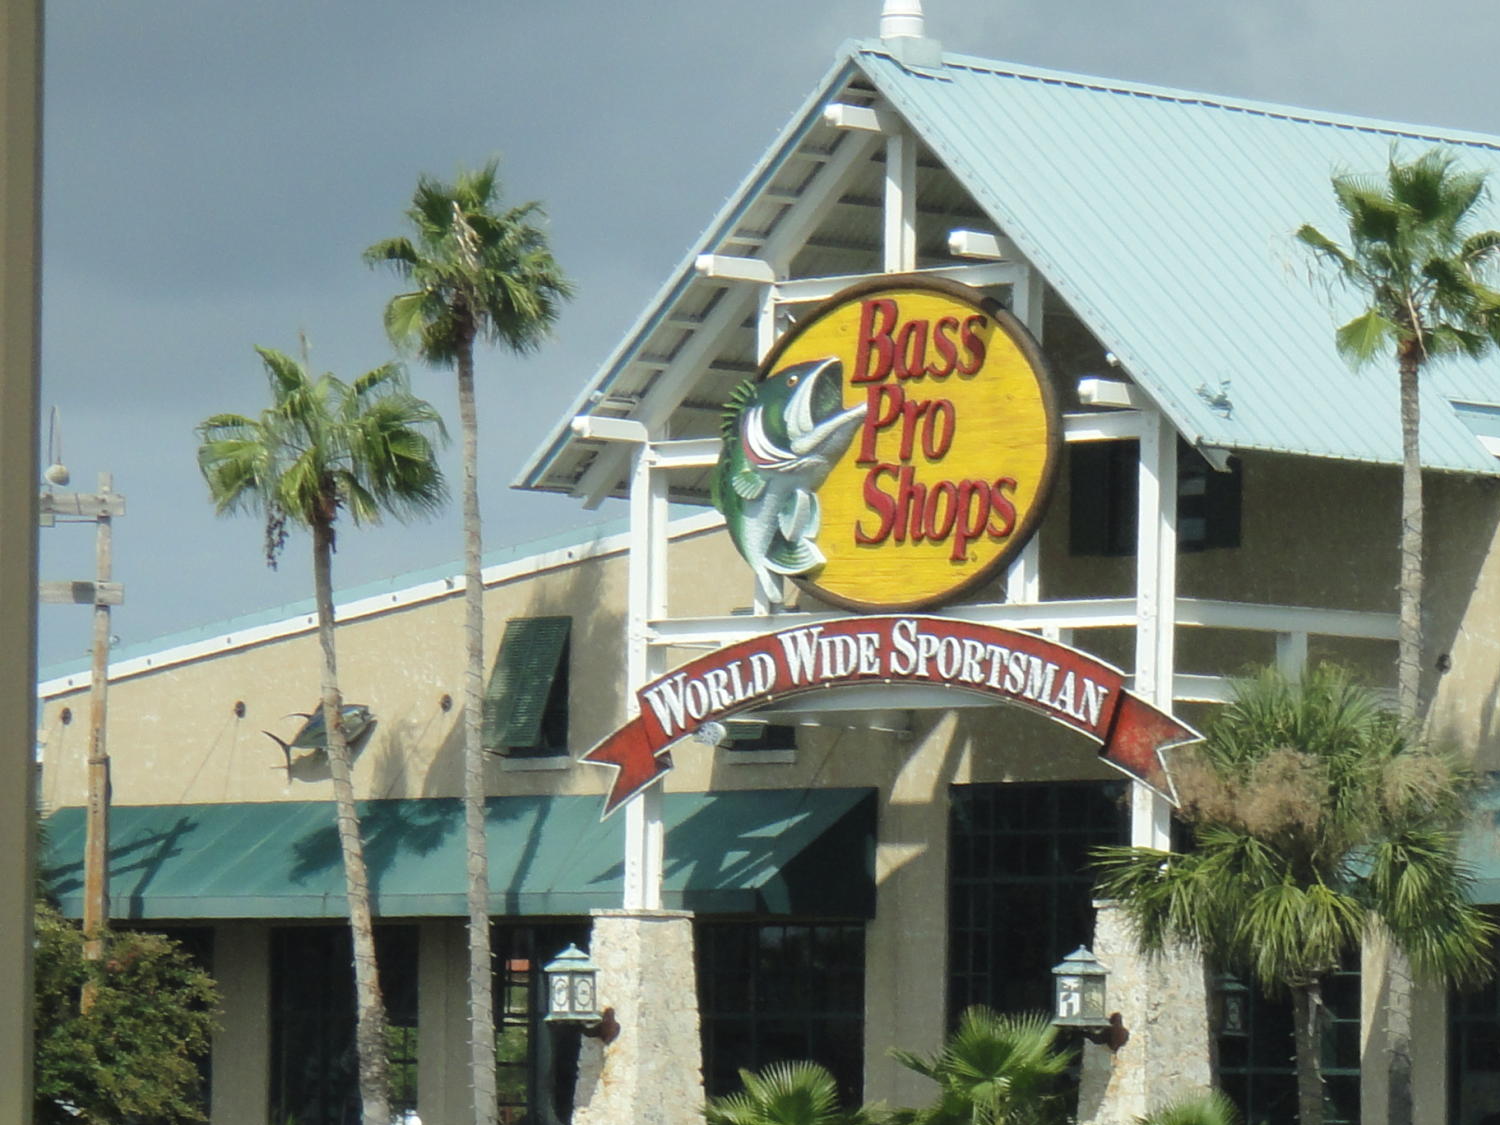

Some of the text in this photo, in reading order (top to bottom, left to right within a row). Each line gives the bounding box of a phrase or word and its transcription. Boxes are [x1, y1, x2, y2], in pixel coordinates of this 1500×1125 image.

[850, 298, 988, 383] Bass
[855, 384, 956, 464] Pro
[854, 463, 1017, 561] Shops
[644, 619, 1110, 737] WORLD WIDE SPORTSMAN
